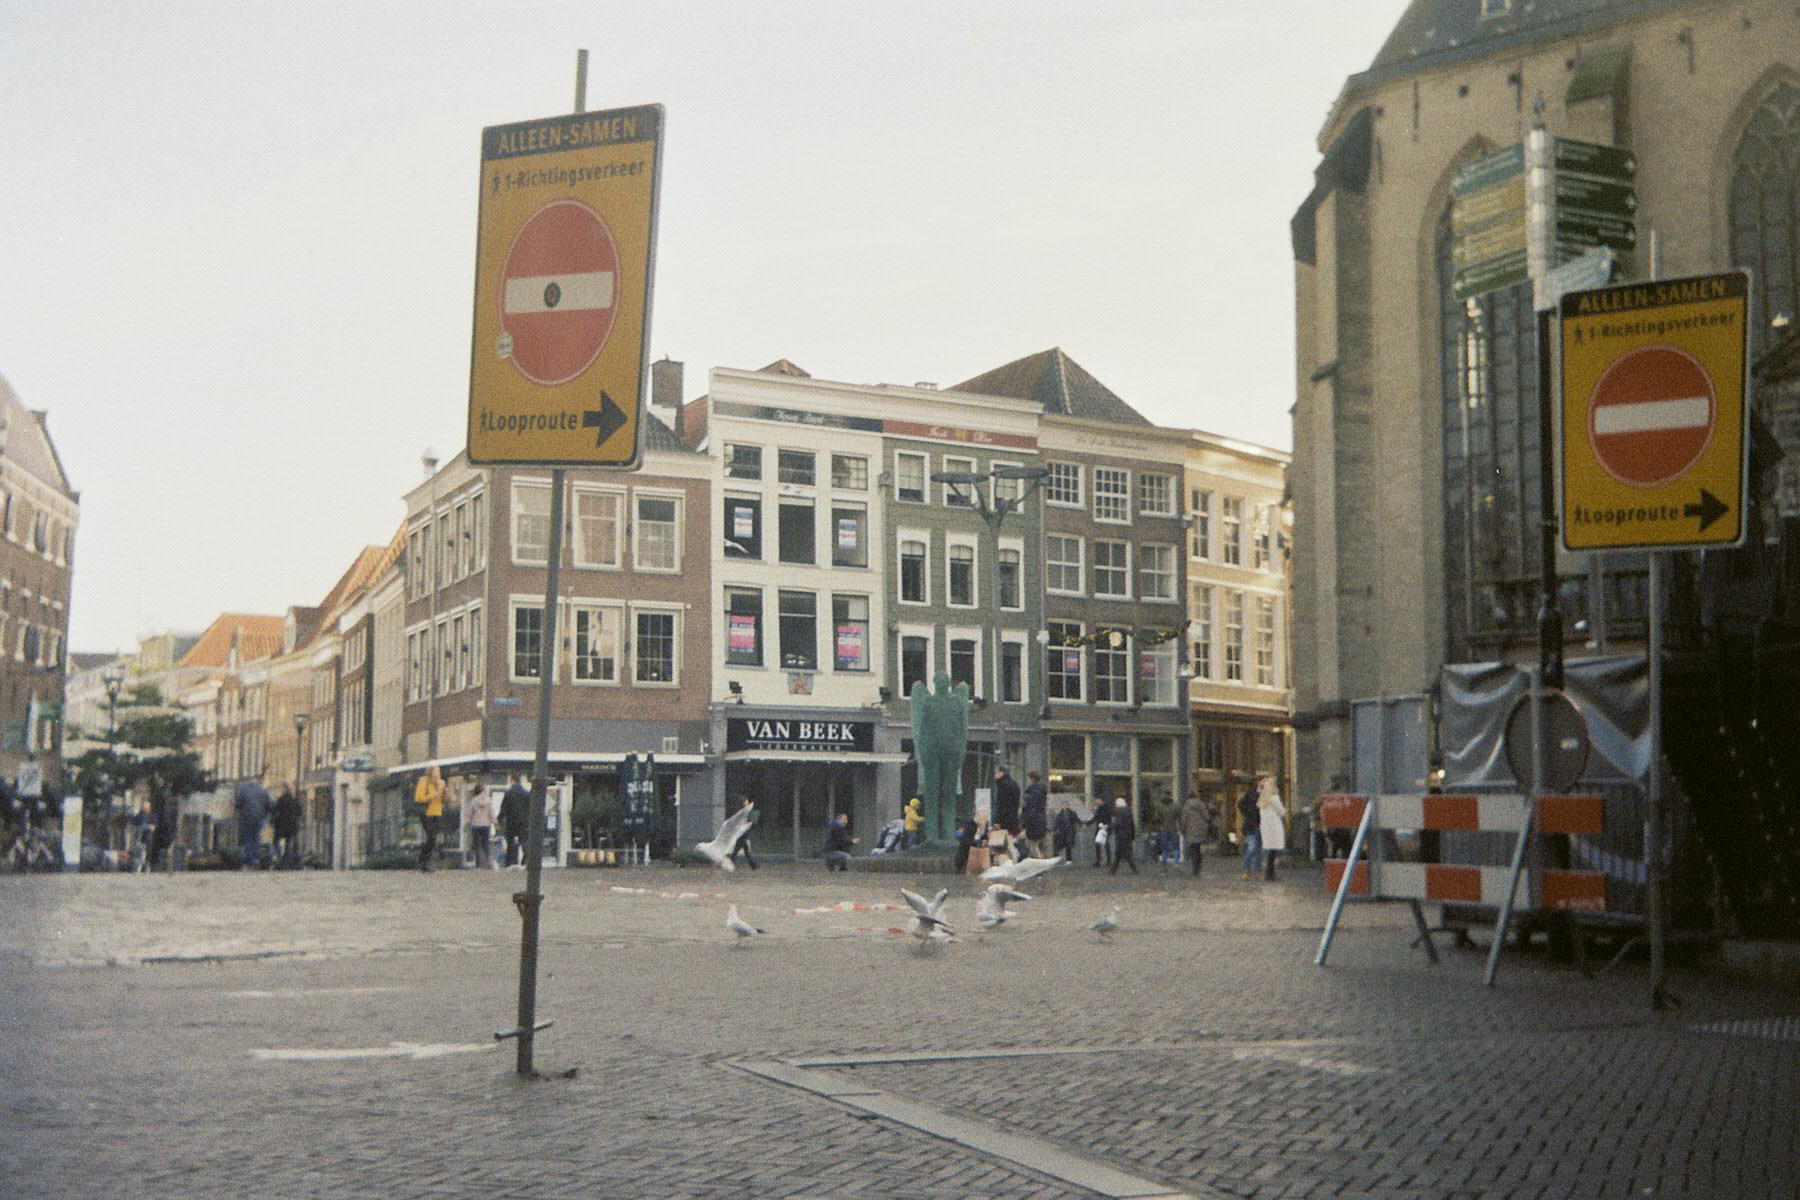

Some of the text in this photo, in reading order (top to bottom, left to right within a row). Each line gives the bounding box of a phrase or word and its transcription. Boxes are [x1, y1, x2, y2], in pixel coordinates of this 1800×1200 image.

[502, 116, 637, 153] ALLEEN-SAMEN
[1578, 279, 1726, 311] ALLEEN-SAMEN
[488, 410, 578, 435] Looproute
[1583, 504, 1679, 526] Looproute
[746, 720, 855, 740] VAN BEEK
